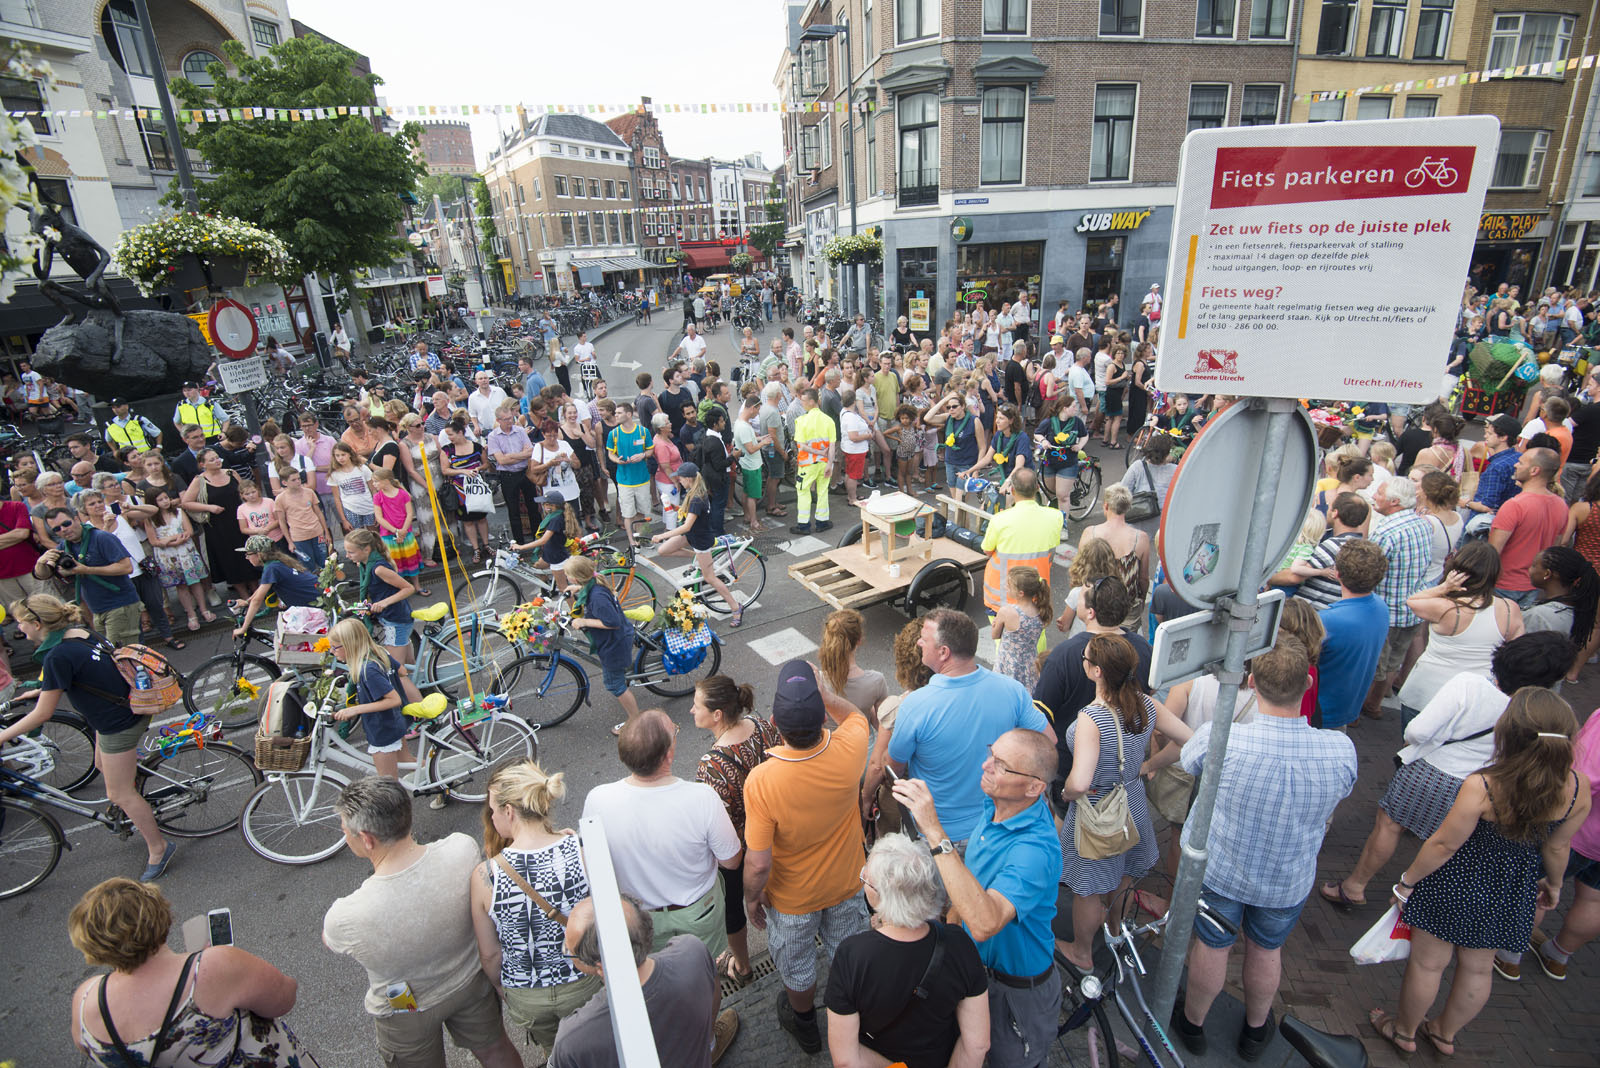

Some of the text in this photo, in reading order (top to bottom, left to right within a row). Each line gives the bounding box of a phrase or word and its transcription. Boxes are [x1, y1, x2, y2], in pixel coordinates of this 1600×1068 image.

[1221, 166, 1395, 190] Fiets parkeren
[1076, 211, 1151, 232] SUBWAY
[1210, 218, 1452, 236] Zet uw fiets op de juiste plek
[1478, 213, 1540, 232] FAIR PLAY
[1488, 230, 1525, 239] CASINO
[1242, 242, 1286, 250] fietsenrek,
[1289, 241, 1355, 250] fietsparkeervak
[1359, 241, 1368, 249] of
[1371, 240, 1404, 250] stalling
[1257, 252, 1266, 260] 14
[1269, 252, 1295, 262] dagen
[1311, 252, 1349, 260] dezelfde
[1351, 252, 1370, 261] plek
[1235, 264, 1279, 272] uitgangen,
[1282, 264, 1304, 272] loop-
[1319, 263, 1356, 272] rijroutes
[1359, 263, 1374, 272] vrij
[1202, 286, 1284, 300] Fiets weg?
[1277, 303, 1322, 312] regelmatig
[1325, 304, 1354, 312] fietsen
[1377, 304, 1391, 312] die
[1393, 305, 1437, 313] gevaarlijk
[1198, 312, 1207, 320] of
[1218, 312, 1236, 321] lang
[1238, 313, 1284, 321] geparkeerd
[1315, 314, 1331, 322] Kijk
[1347, 314, 1414, 323] Utrecht.nl/fiets
[1344, 377, 1424, 389] Utrecht.nl/fiets
